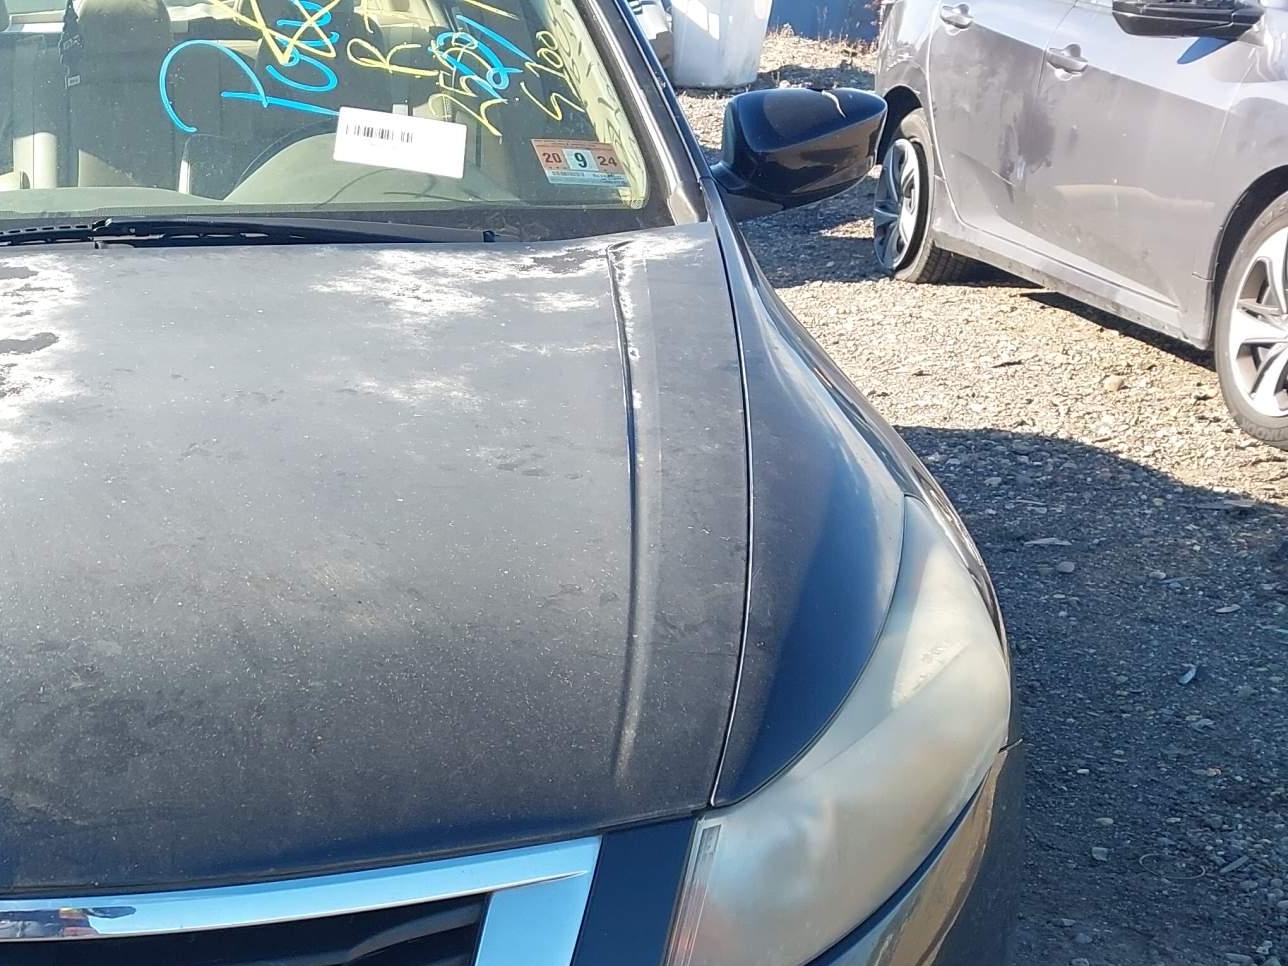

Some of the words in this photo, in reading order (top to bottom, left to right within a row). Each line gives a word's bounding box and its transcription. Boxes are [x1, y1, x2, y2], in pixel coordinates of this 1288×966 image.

[542, 152, 563, 164] 20
[574, 152, 588, 168] 9
[596, 155, 618, 168] 24
